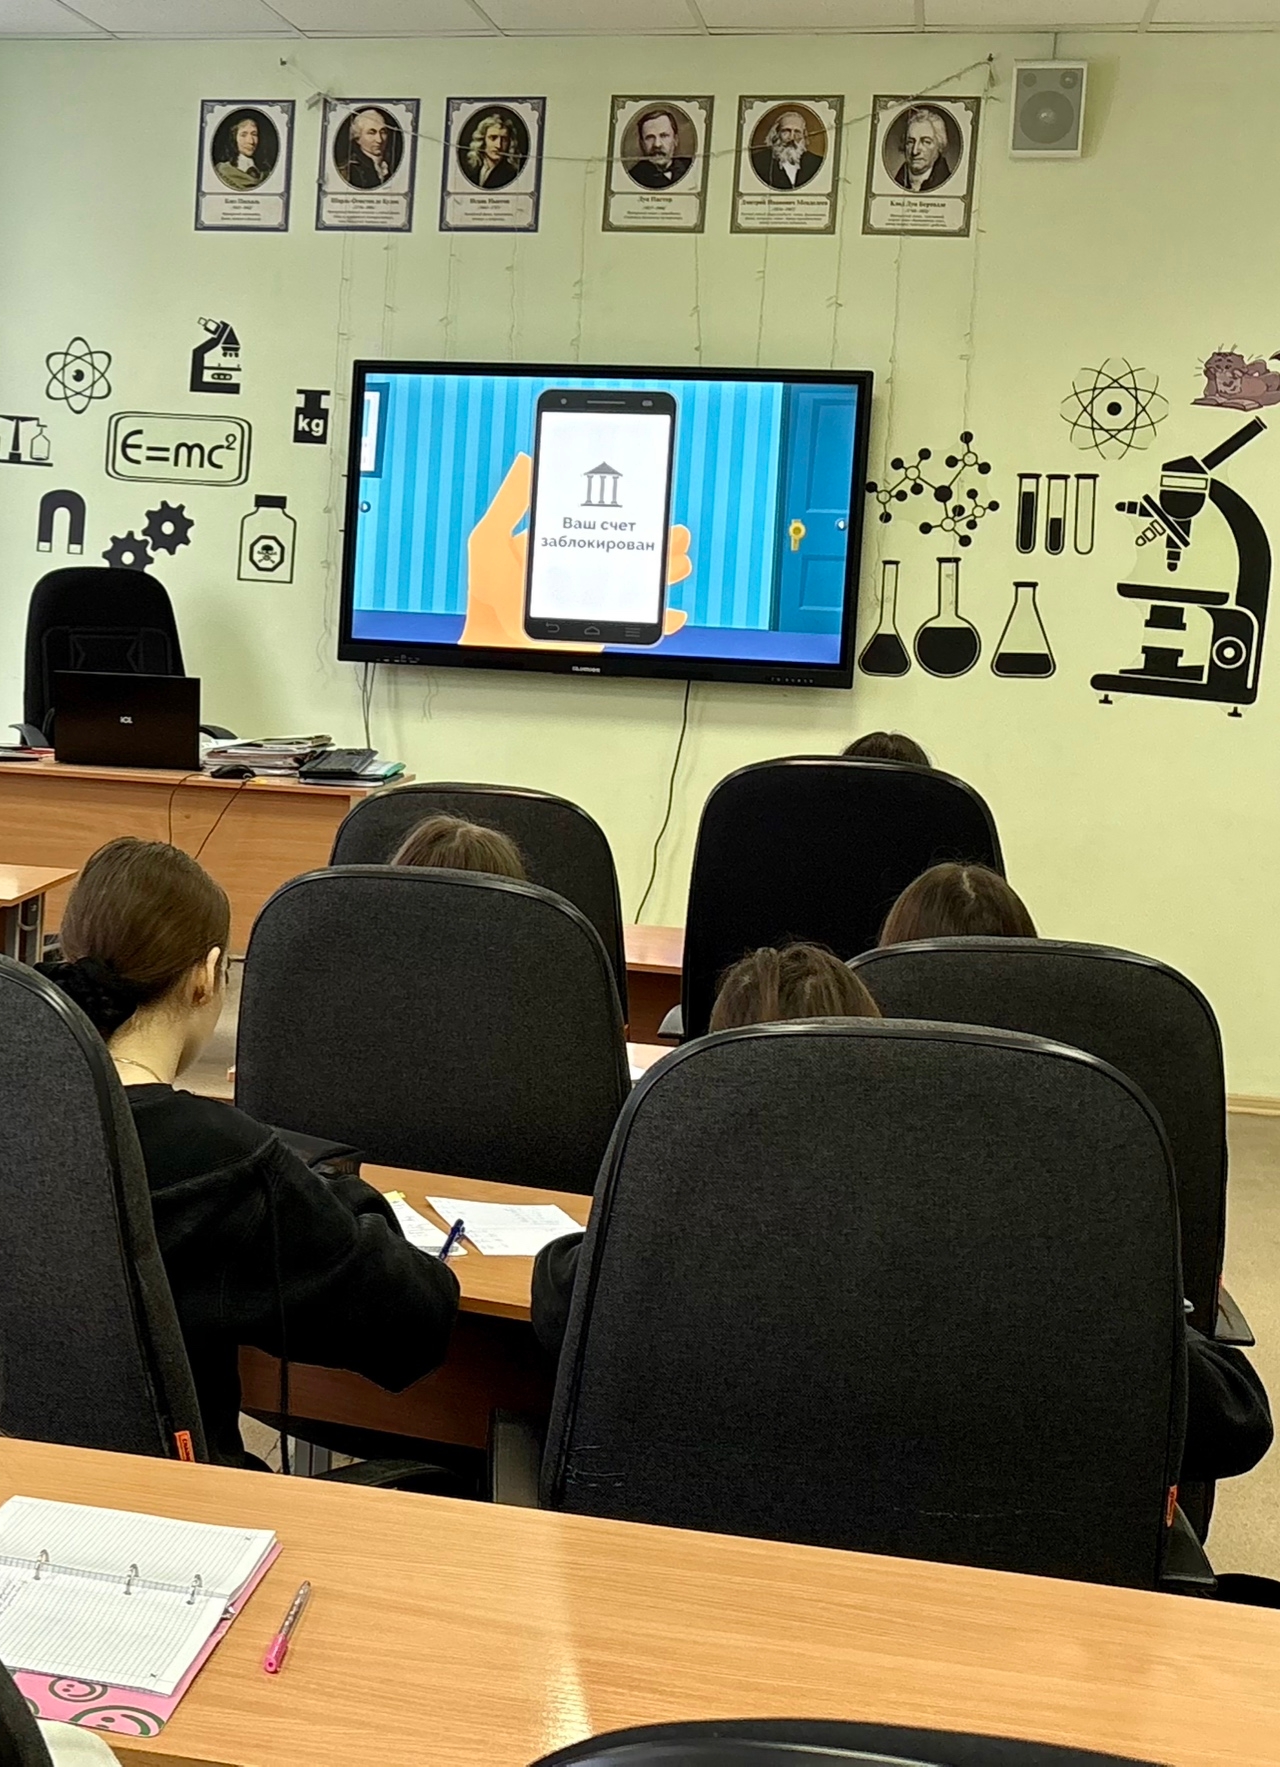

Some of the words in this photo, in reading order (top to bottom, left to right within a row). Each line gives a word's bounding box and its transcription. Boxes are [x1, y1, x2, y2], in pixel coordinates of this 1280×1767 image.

[298, 413, 324, 437] kg
[562, 516, 596, 530] Ваш
[600, 520, 636, 532] счет
[541, 535, 655, 553] заблокирован
